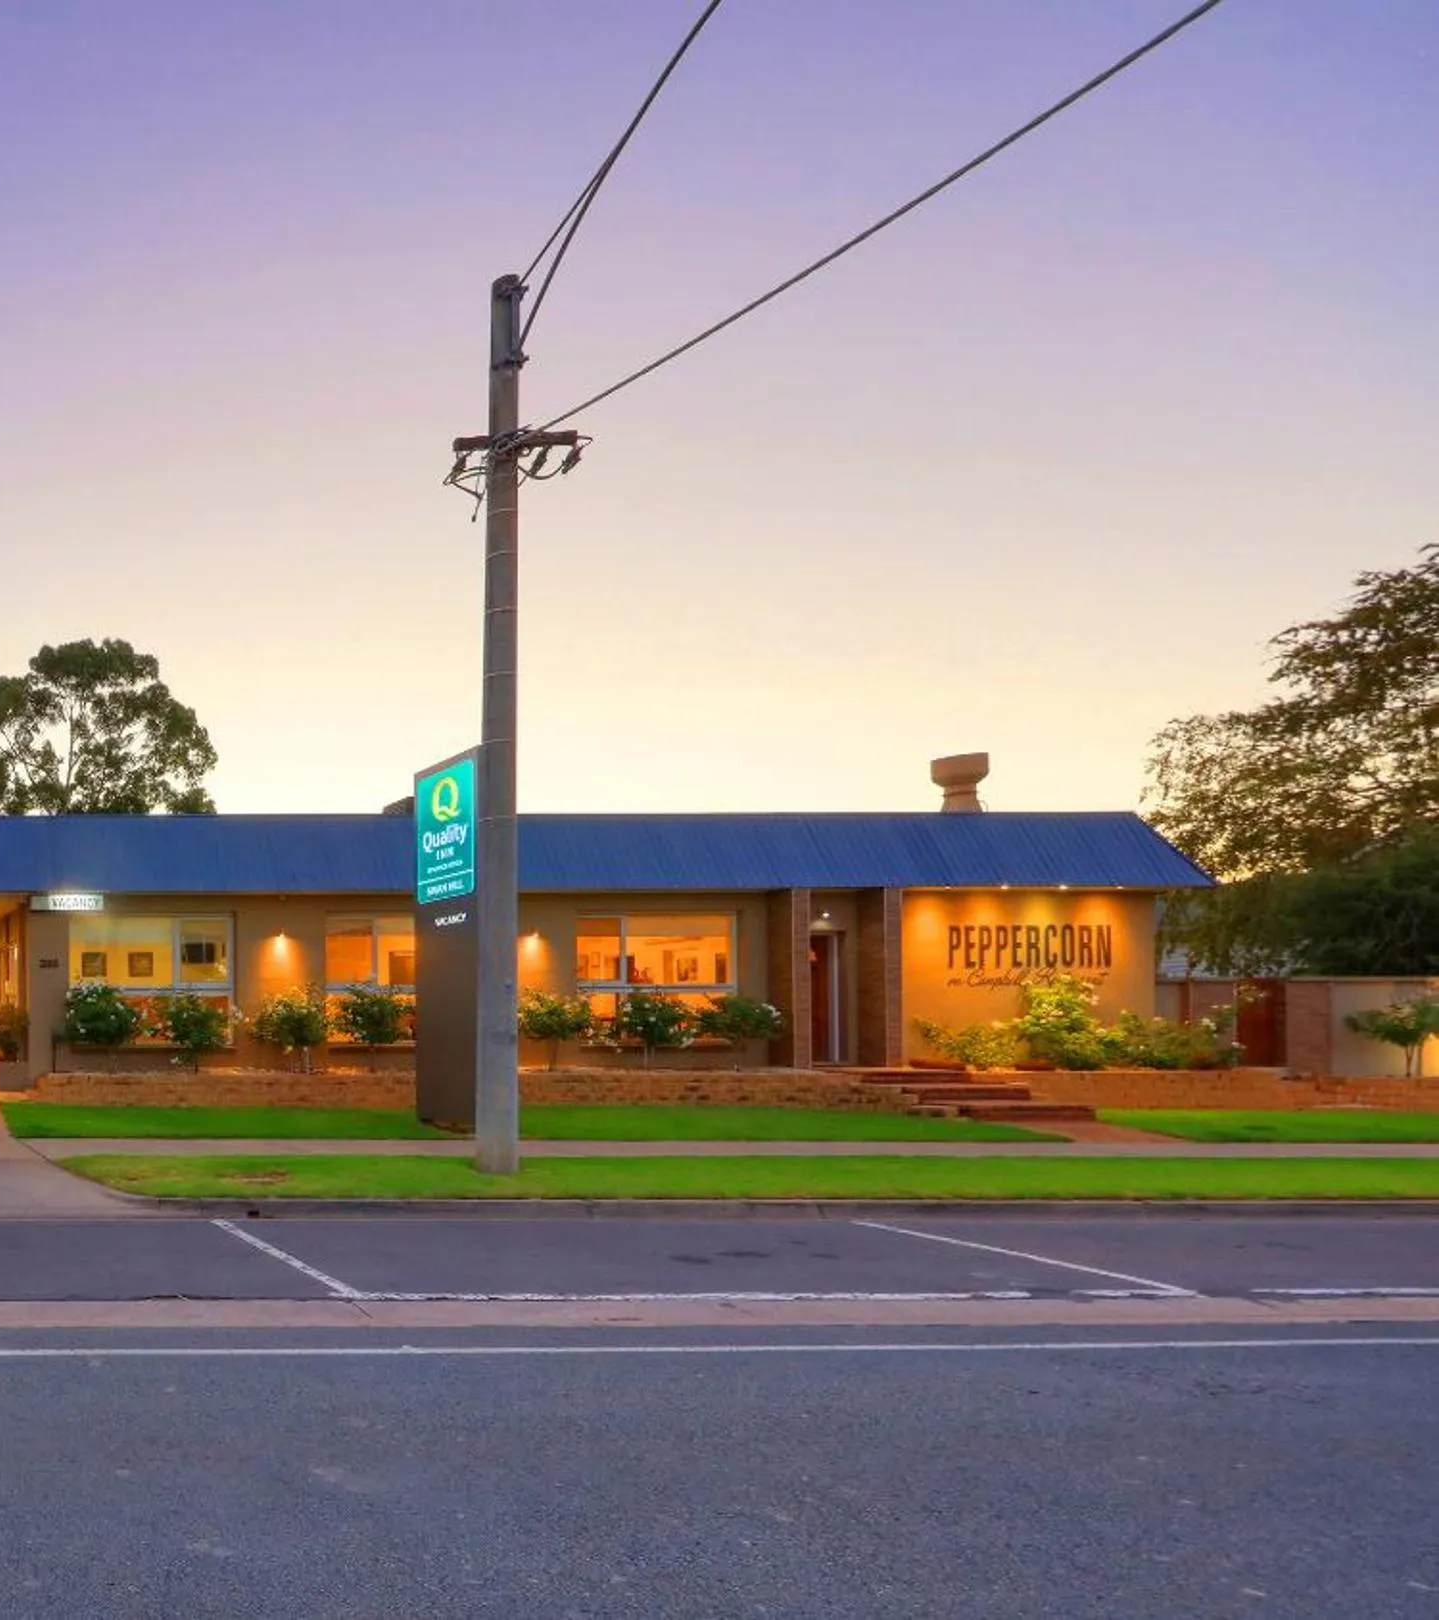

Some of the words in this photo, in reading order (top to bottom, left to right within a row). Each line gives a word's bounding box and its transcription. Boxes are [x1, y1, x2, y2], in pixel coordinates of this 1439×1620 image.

[432, 776, 460, 822] Q
[423, 823, 468, 852] Quality
[436, 846, 455, 861] INN
[947, 924, 1112, 969] PEPPERCORN
